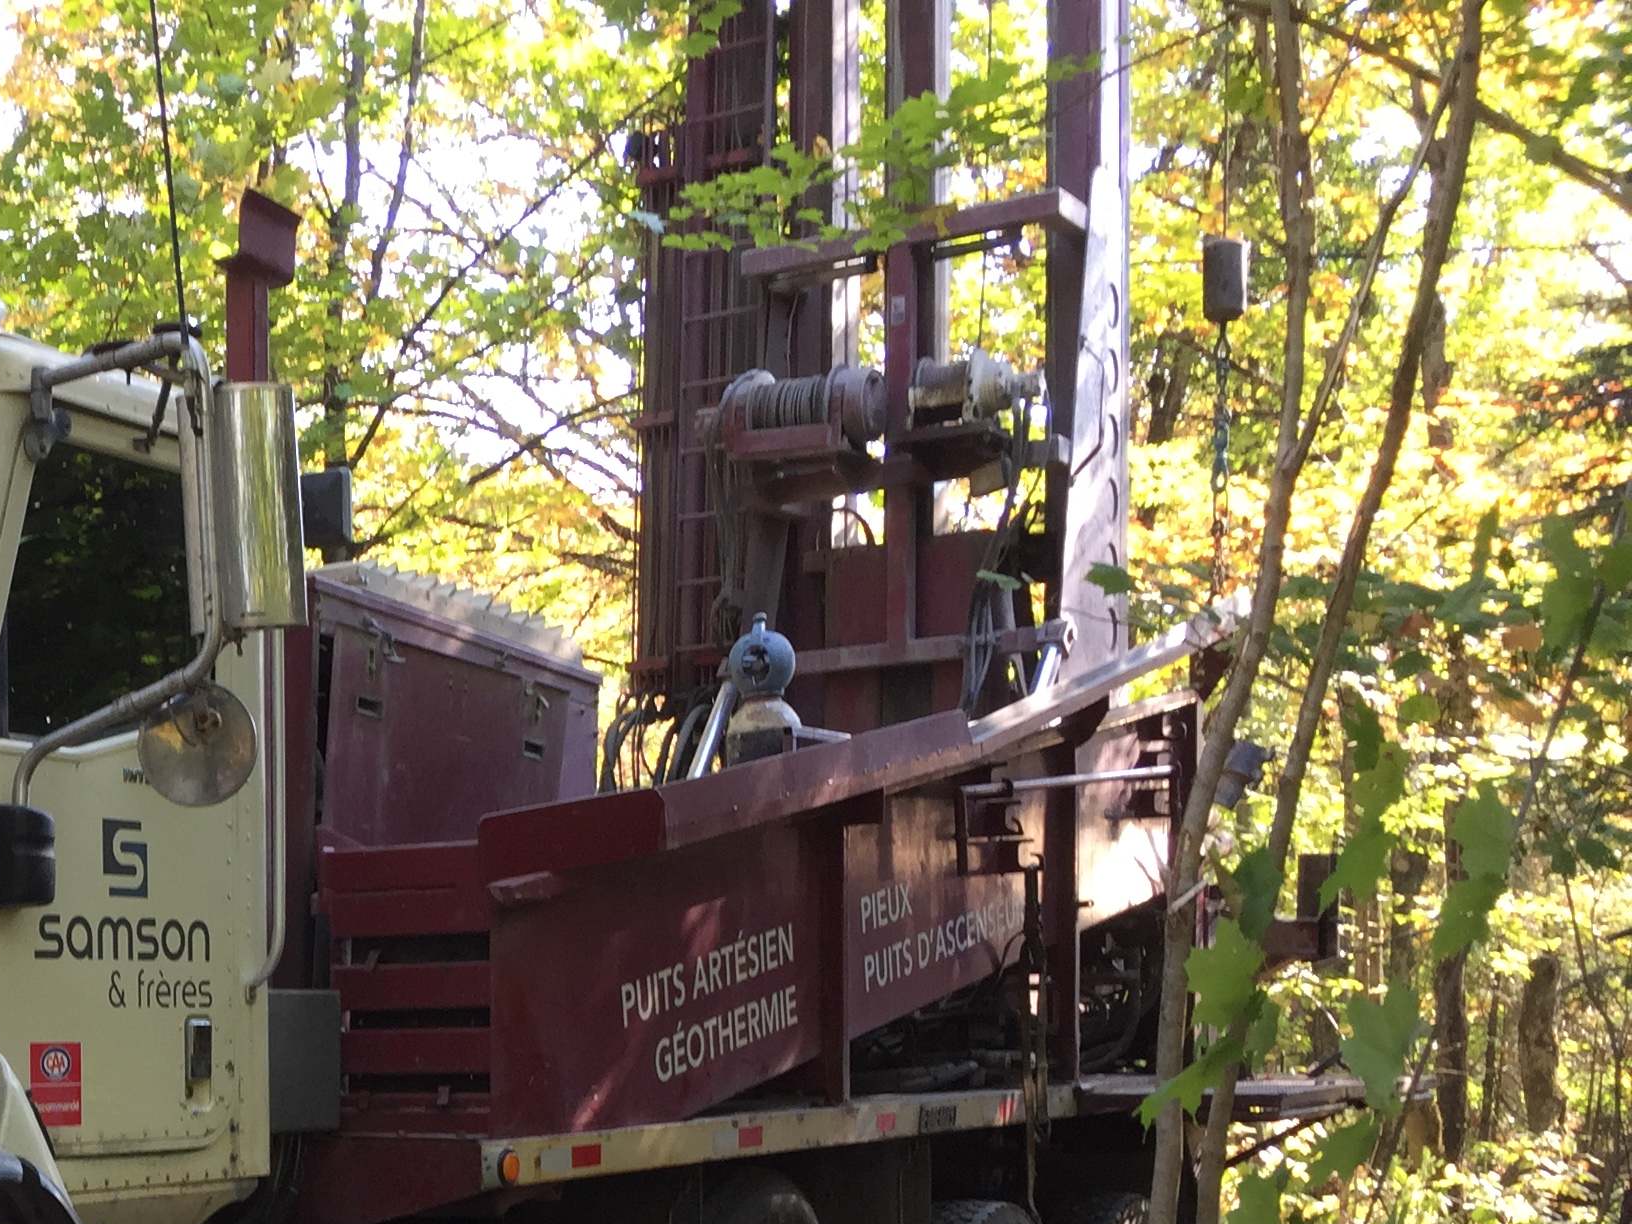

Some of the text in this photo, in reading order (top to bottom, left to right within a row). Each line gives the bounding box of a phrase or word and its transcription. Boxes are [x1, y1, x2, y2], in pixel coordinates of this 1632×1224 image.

[860, 883, 913, 935] PIEUX
[34, 914, 211, 962] samson
[864, 936, 914, 993] PUITS
[108, 968, 213, 1009] & frères
[621, 922, 795, 1029] PUITS ARTÉSIEN
[655, 984, 799, 1083] GÉOTHERMIE
